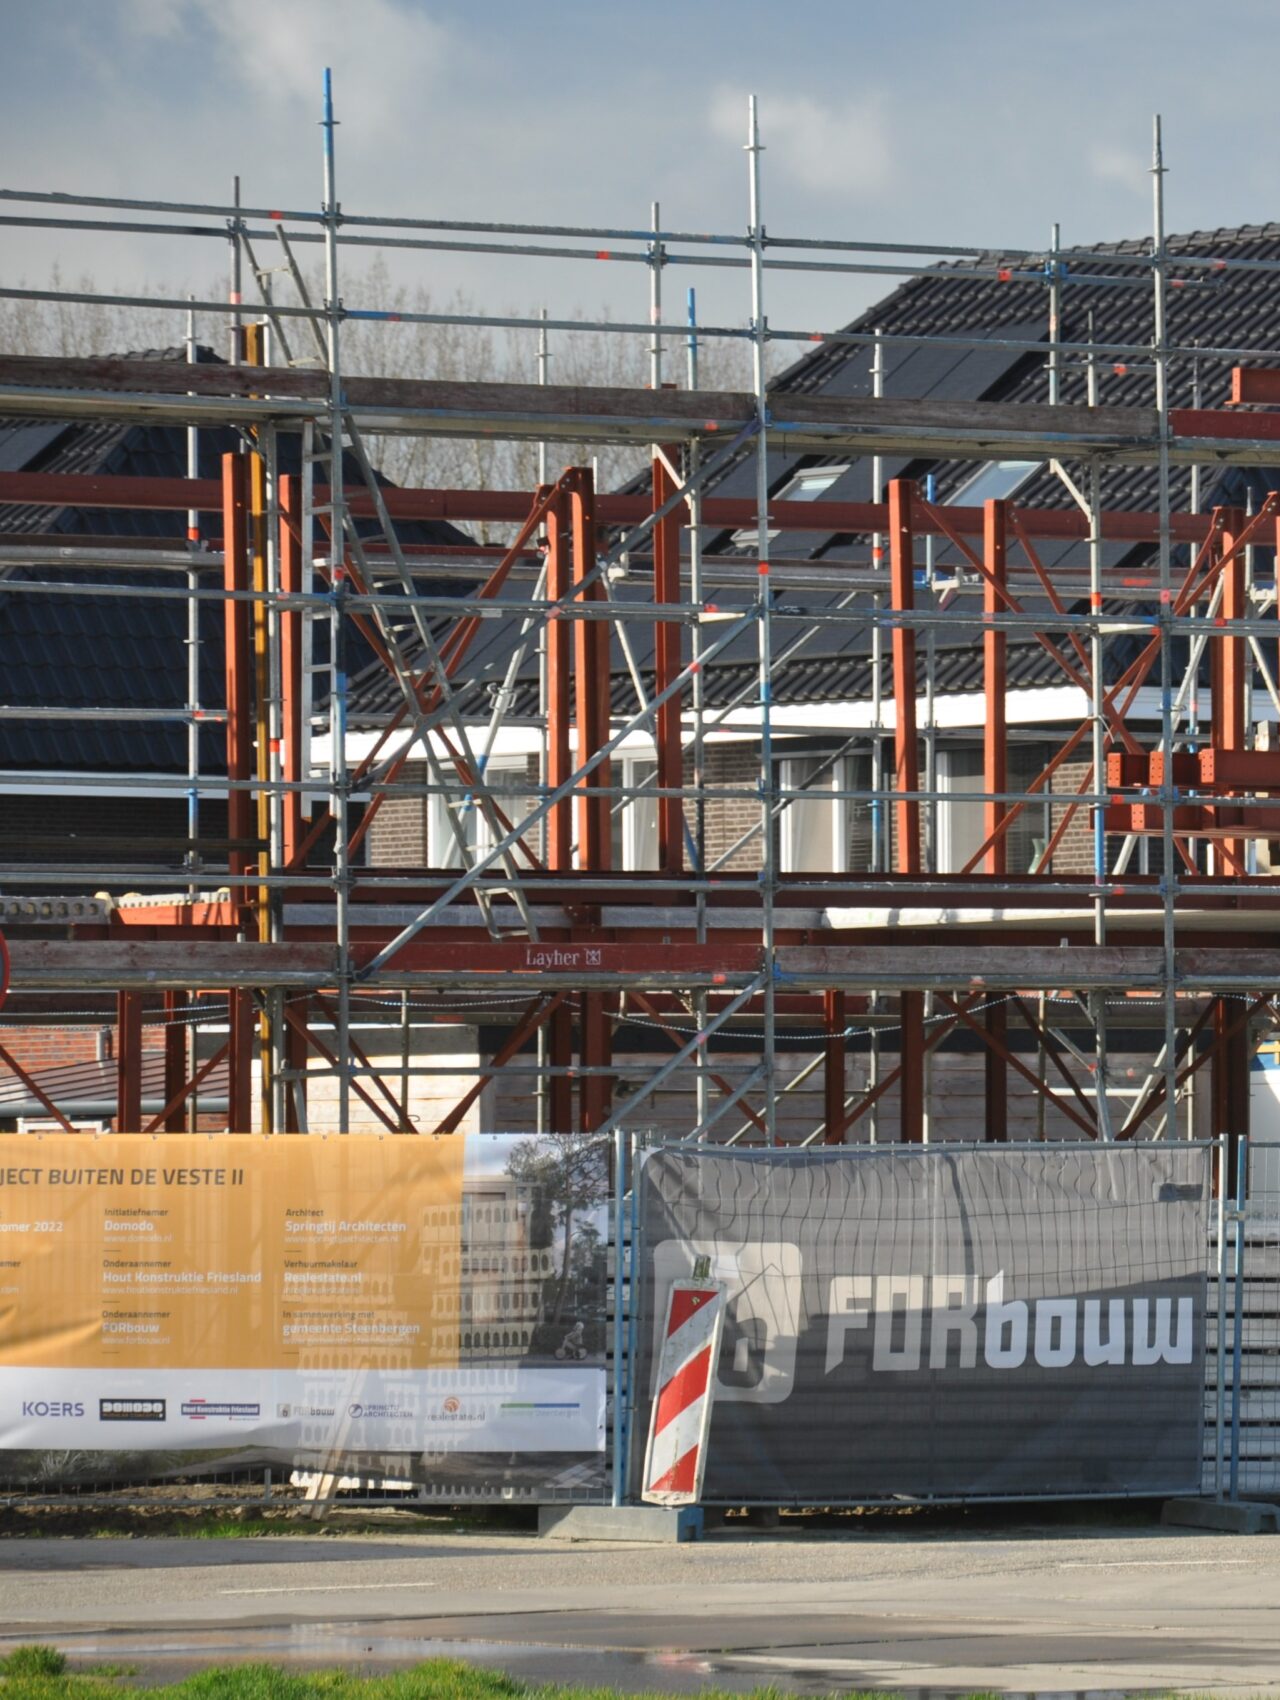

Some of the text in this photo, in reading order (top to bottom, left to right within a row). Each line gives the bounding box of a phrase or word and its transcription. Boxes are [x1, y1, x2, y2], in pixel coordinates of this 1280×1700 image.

[526, 949, 580, 969] Layher
[48, 1168, 124, 1185] BUITEN
[130, 1168, 157, 1185] DE
[162, 1168, 227, 1185] VESTE
[231, 1168, 244, 1185] II
[104, 1208, 169, 1217] Initiatiefnemer
[285, 1208, 324, 1217] Architect
[33, 1220, 64, 1232] 2022
[104, 1220, 154, 1231] Domodo
[285, 1220, 407, 1234] Springtij Architecten
[103, 1259, 172, 1268] Onderaannemer
[102, 1272, 262, 1283] Hout Konstruktie Friesland
[825, 1268, 1194, 1376] FORbouw
[102, 1323, 160, 1334] FORbouw
[22, 1401, 85, 1417] KOERS
